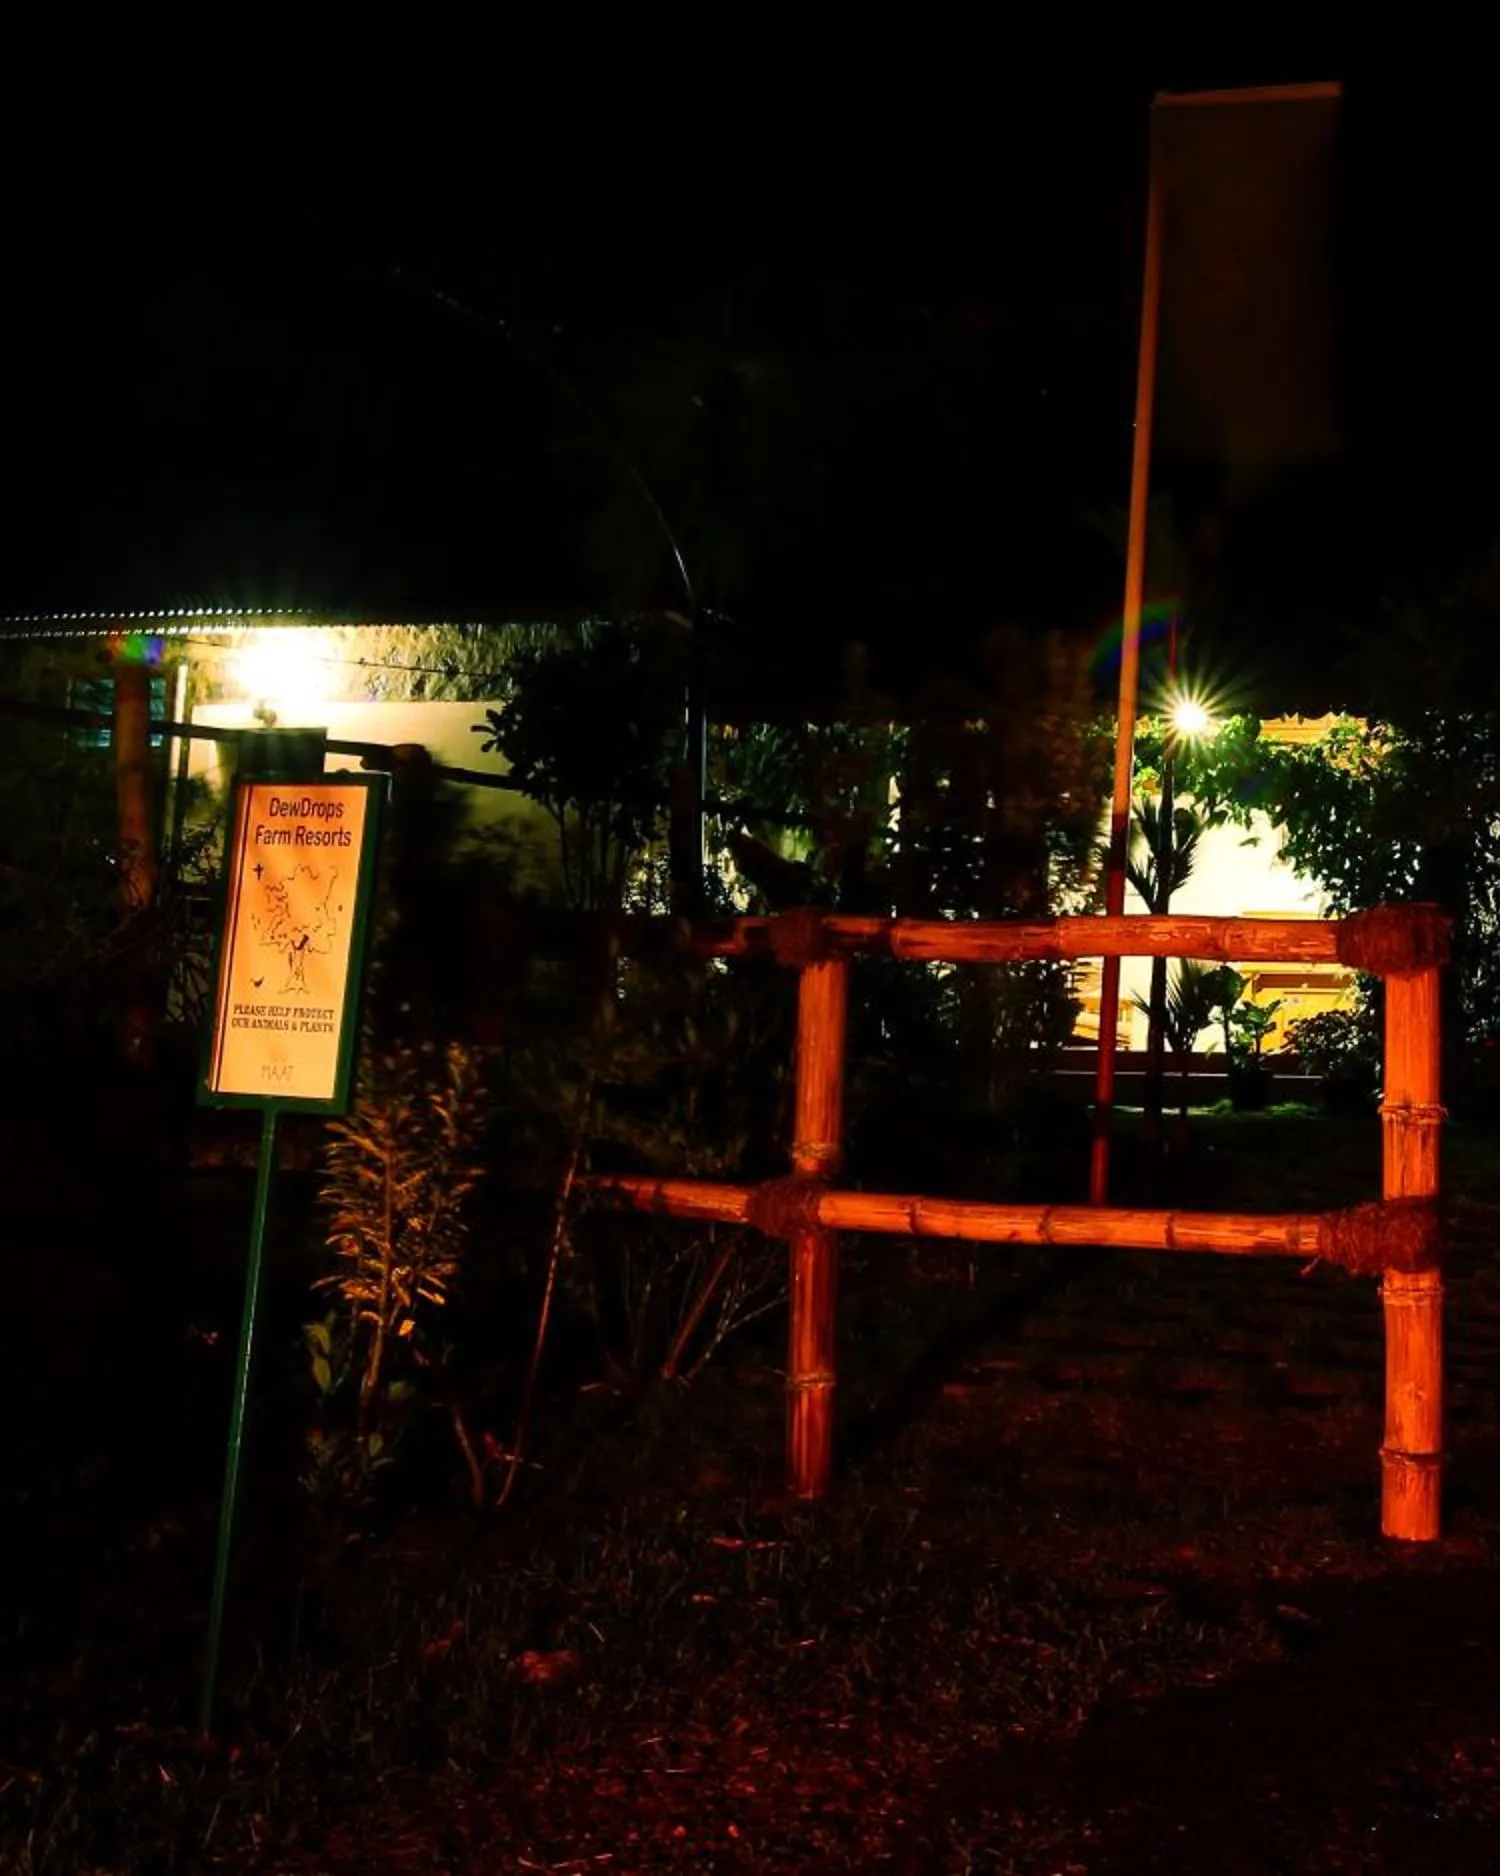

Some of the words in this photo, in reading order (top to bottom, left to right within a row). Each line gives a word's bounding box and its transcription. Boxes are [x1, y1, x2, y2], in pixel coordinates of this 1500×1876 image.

[269, 797, 344, 822] DewDrops
[255, 824, 291, 845] Farm
[295, 825, 352, 847] Resorts
[233, 1004, 266, 1016] PLEASE
